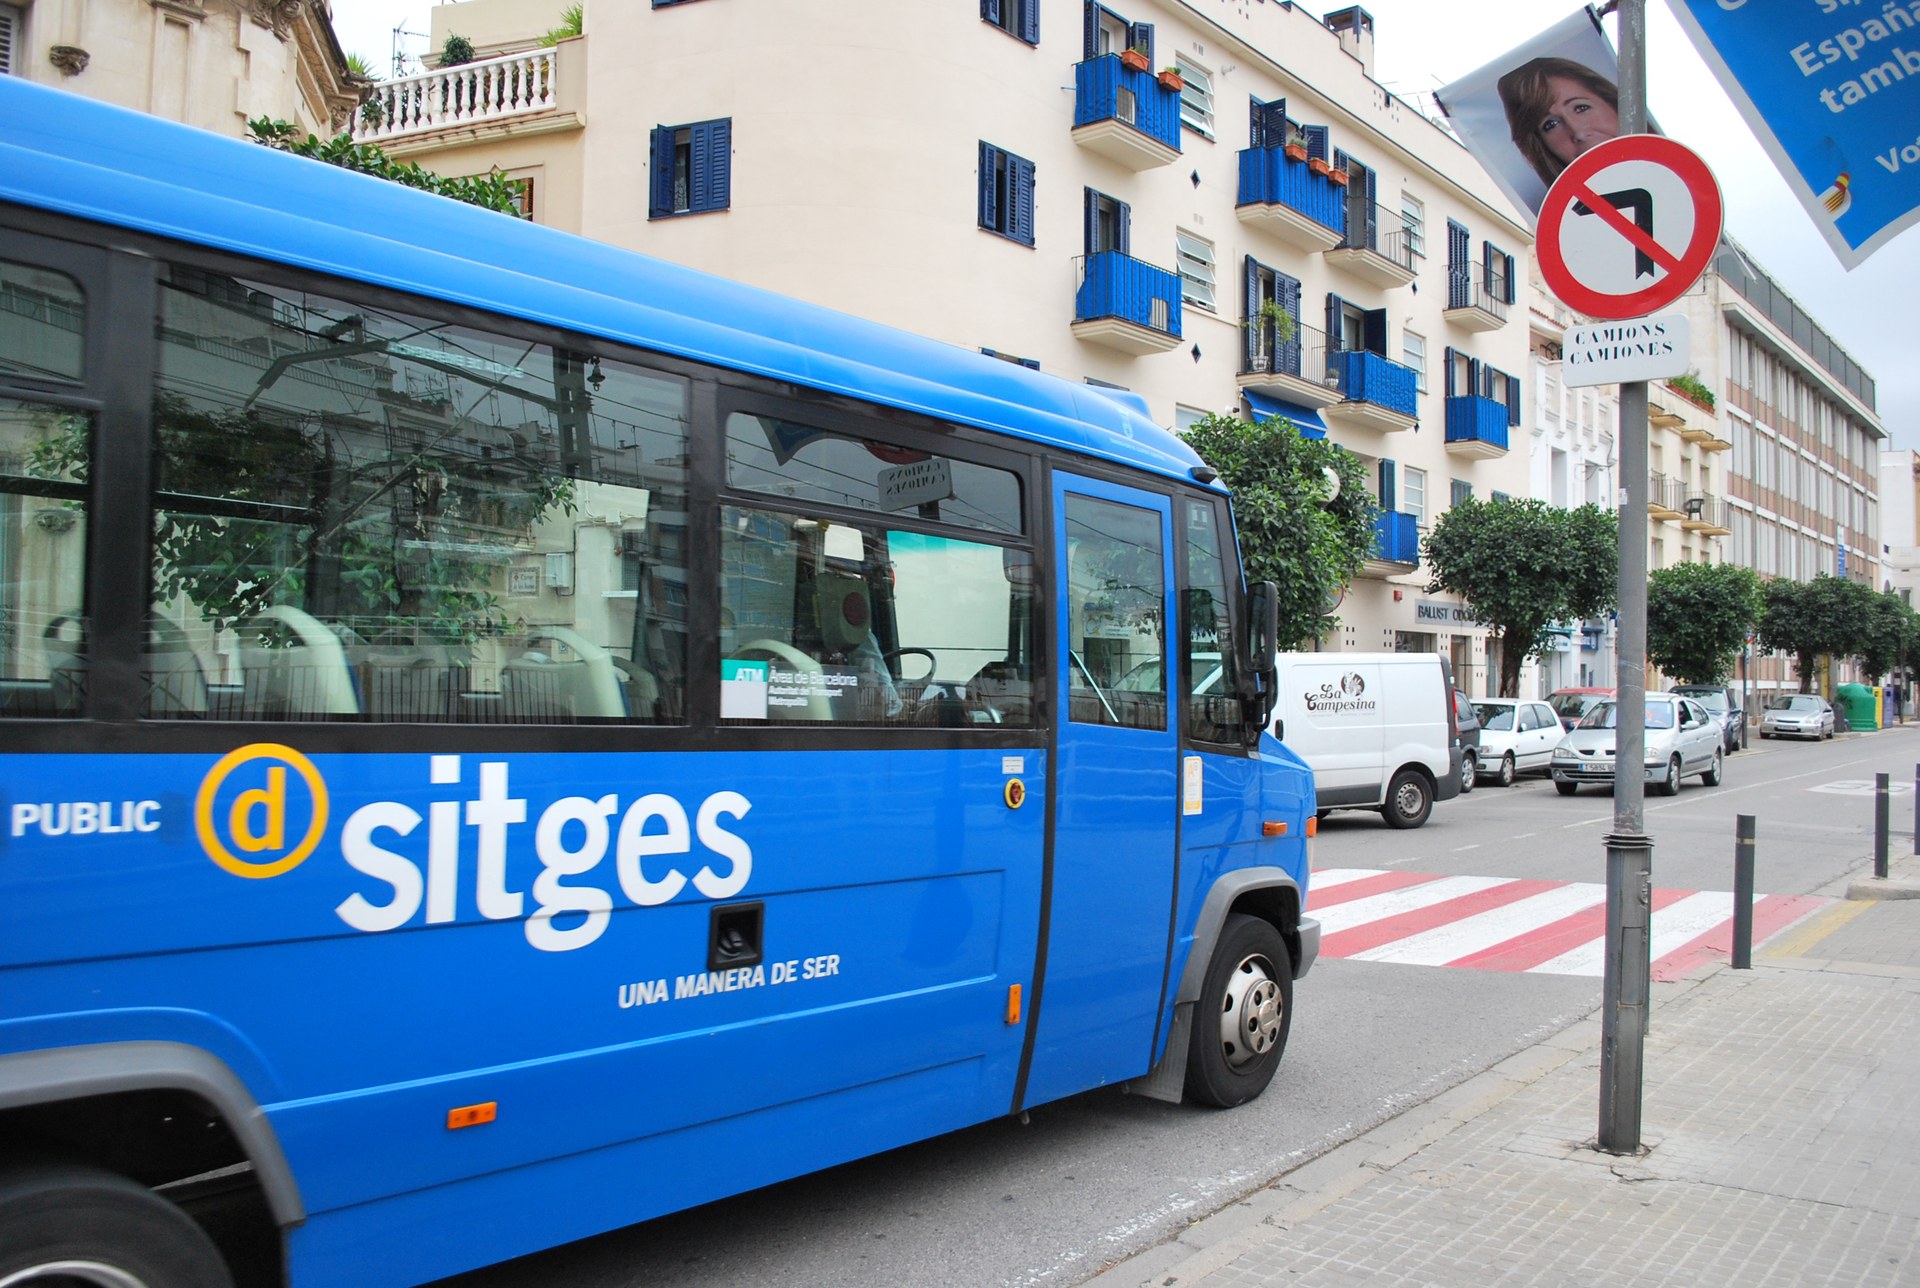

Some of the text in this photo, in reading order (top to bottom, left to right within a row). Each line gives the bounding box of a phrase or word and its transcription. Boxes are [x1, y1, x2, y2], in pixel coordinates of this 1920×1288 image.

[1875, 136, 1920, 174] Vo
[1575, 322, 1666, 346] CAMIONS
[1570, 341, 1673, 365] CAMIONES
[735, 668, 764, 682] ATM
[794, 671, 808, 684] de
[810, 671, 858, 687] Barcelona
[1304, 692, 1376, 713] Campesina
[1320, 684, 1341, 699] La
[11, 800, 161, 837] PUBLIC
[334, 755, 753, 952] sitges
[618, 954, 841, 1009] UNA MANERA DE SER
